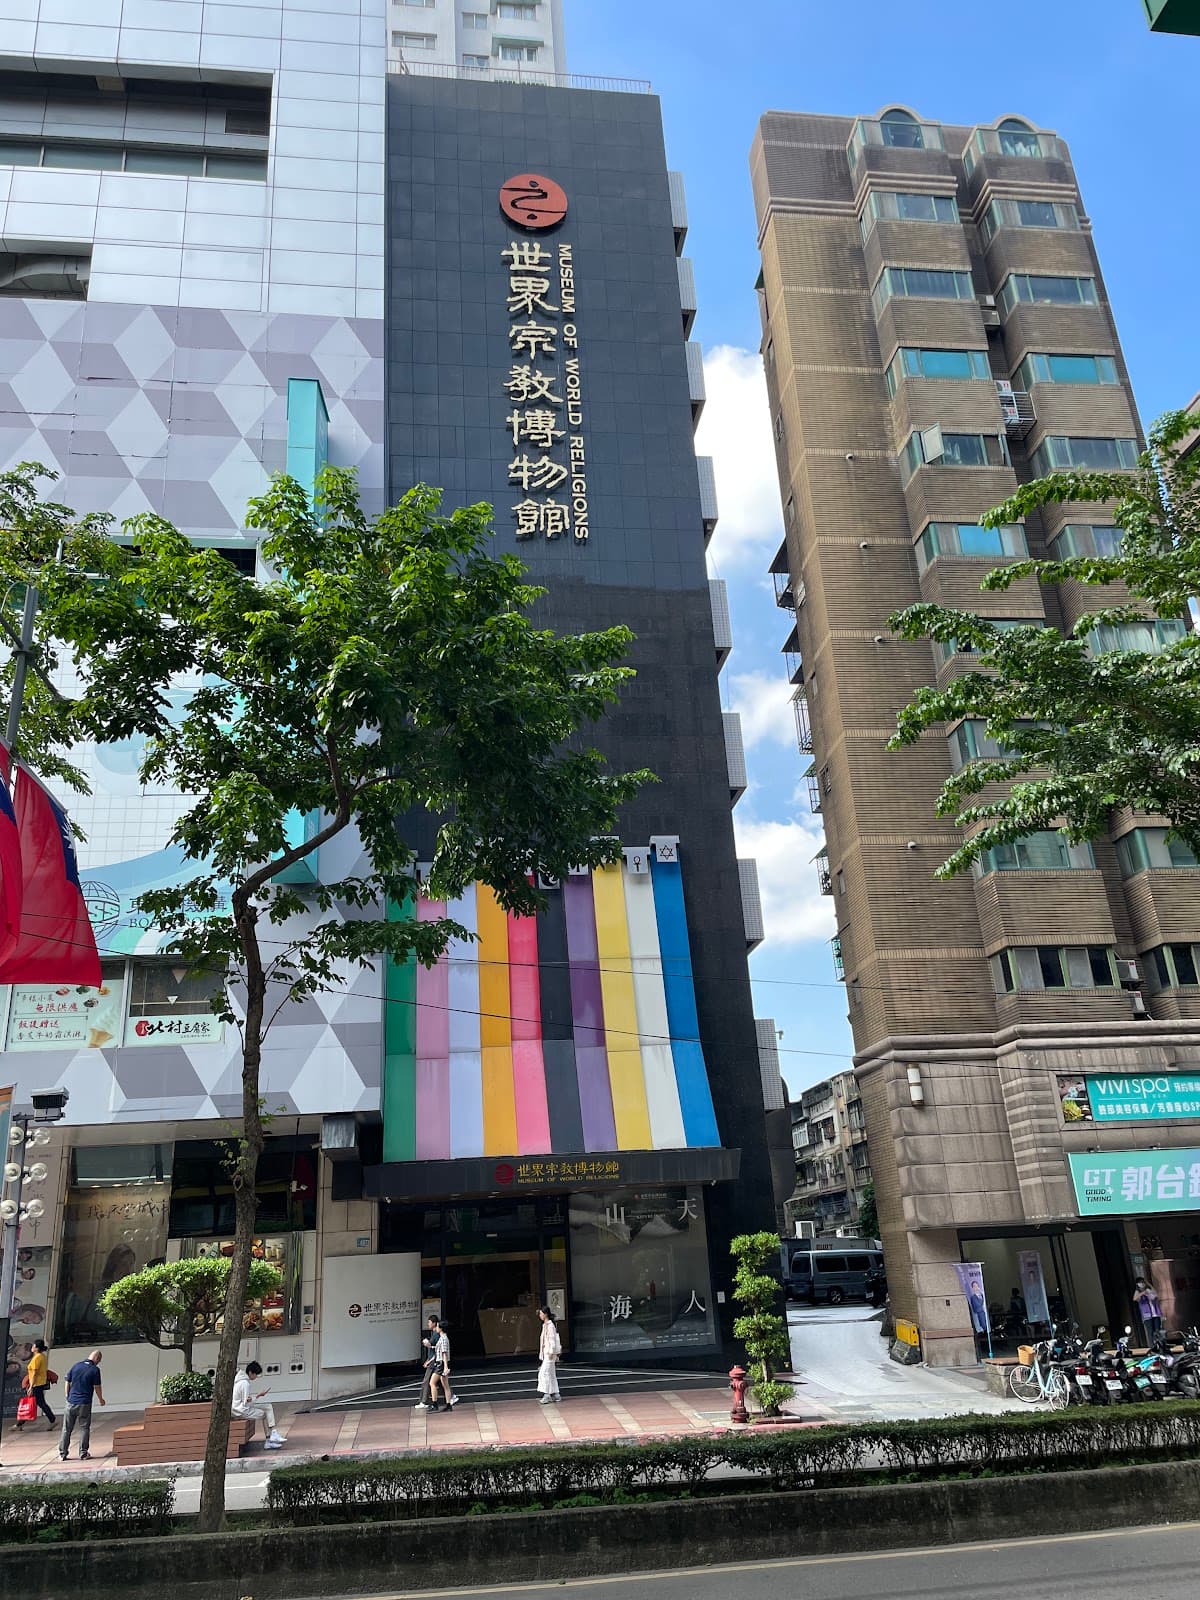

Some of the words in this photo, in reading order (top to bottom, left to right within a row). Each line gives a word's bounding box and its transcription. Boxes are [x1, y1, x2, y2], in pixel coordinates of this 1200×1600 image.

[558, 244, 576, 313] MUSEUM
[563, 324, 578, 348] OF
[501, 242, 569, 538] 世界宗教博物館
[565, 358, 583, 425] WORLD
[570, 436, 589, 539] RELIGIONS
[517, 1161, 620, 1177] 世界宗教博物館
[1083, 1168, 1116, 1186] GT
[606, 1203, 625, 1226] 山
[677, 1198, 698, 1222] 天
[609, 1294, 633, 1321] 海
[684, 1289, 706, 1314] 人
